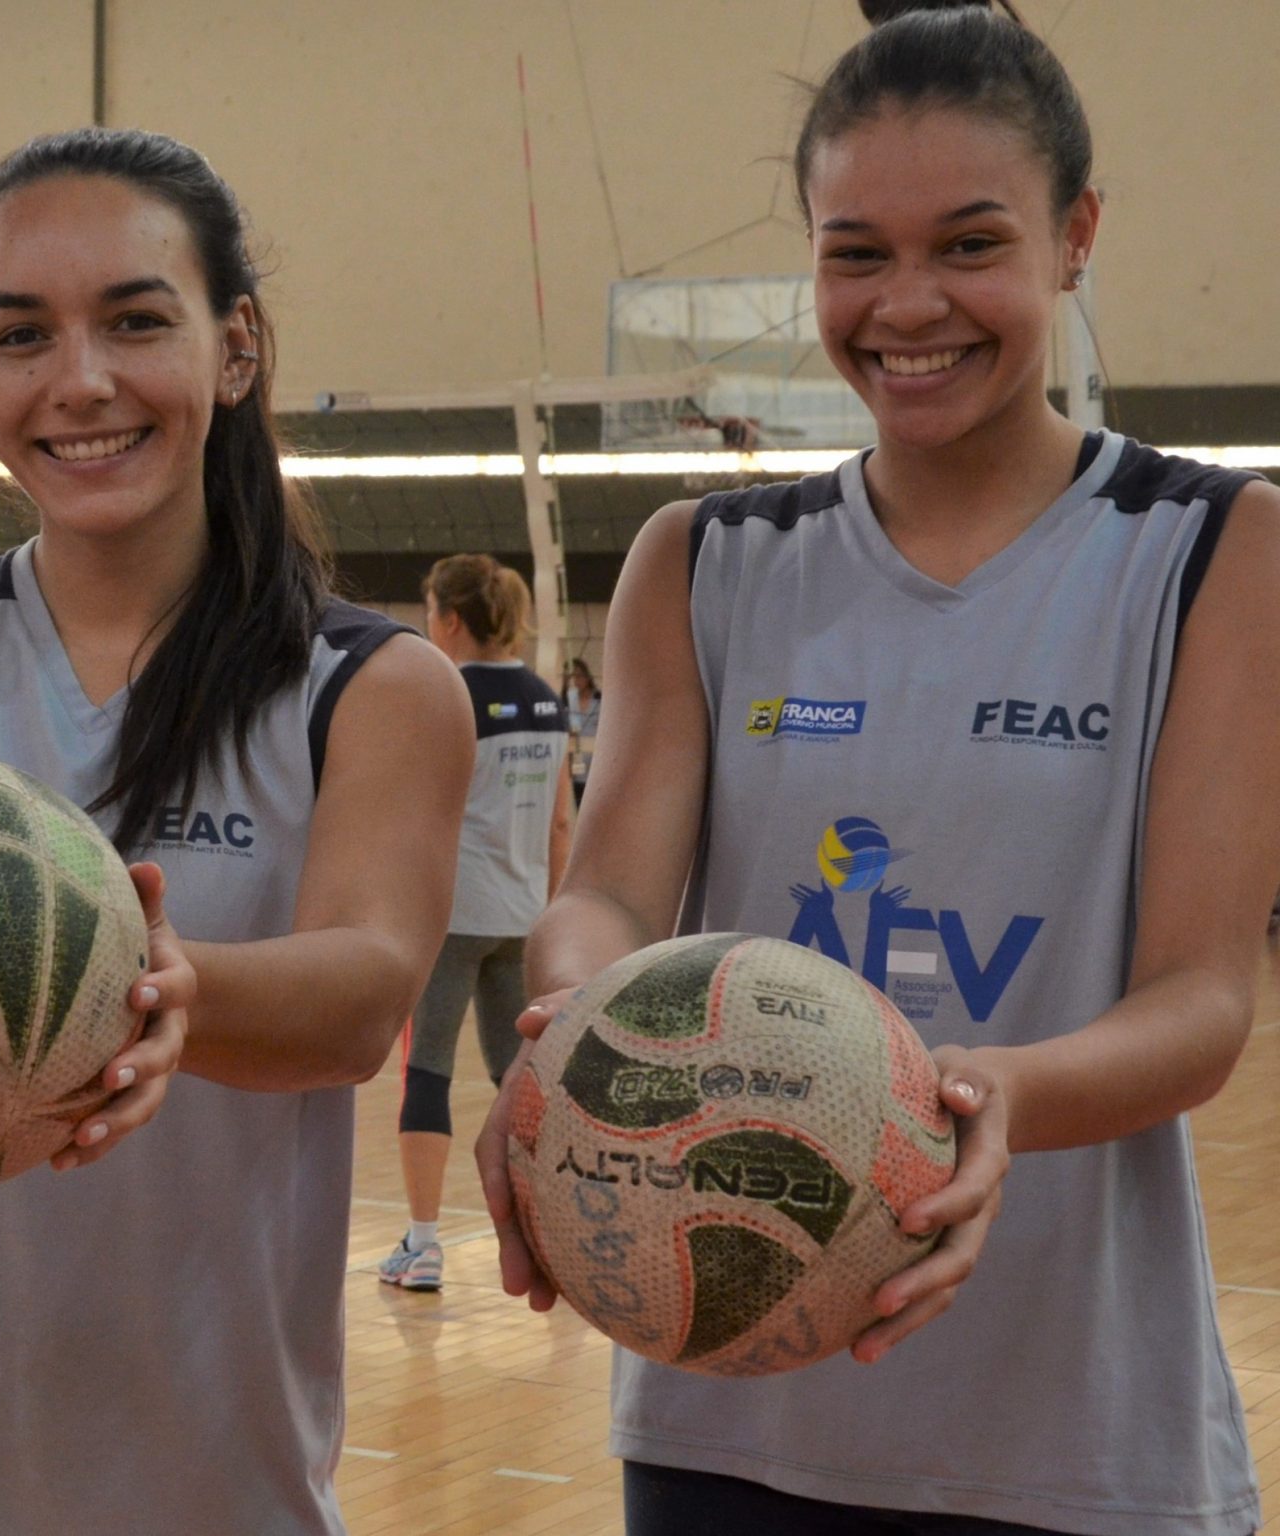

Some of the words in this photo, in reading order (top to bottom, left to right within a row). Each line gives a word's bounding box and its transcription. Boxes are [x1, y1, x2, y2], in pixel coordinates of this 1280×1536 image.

[781, 703, 856, 722] FRANCA
[971, 698, 1110, 741] FEAC
[155, 806, 254, 849] EAC
[555, 1145, 834, 1208] PENALTY
